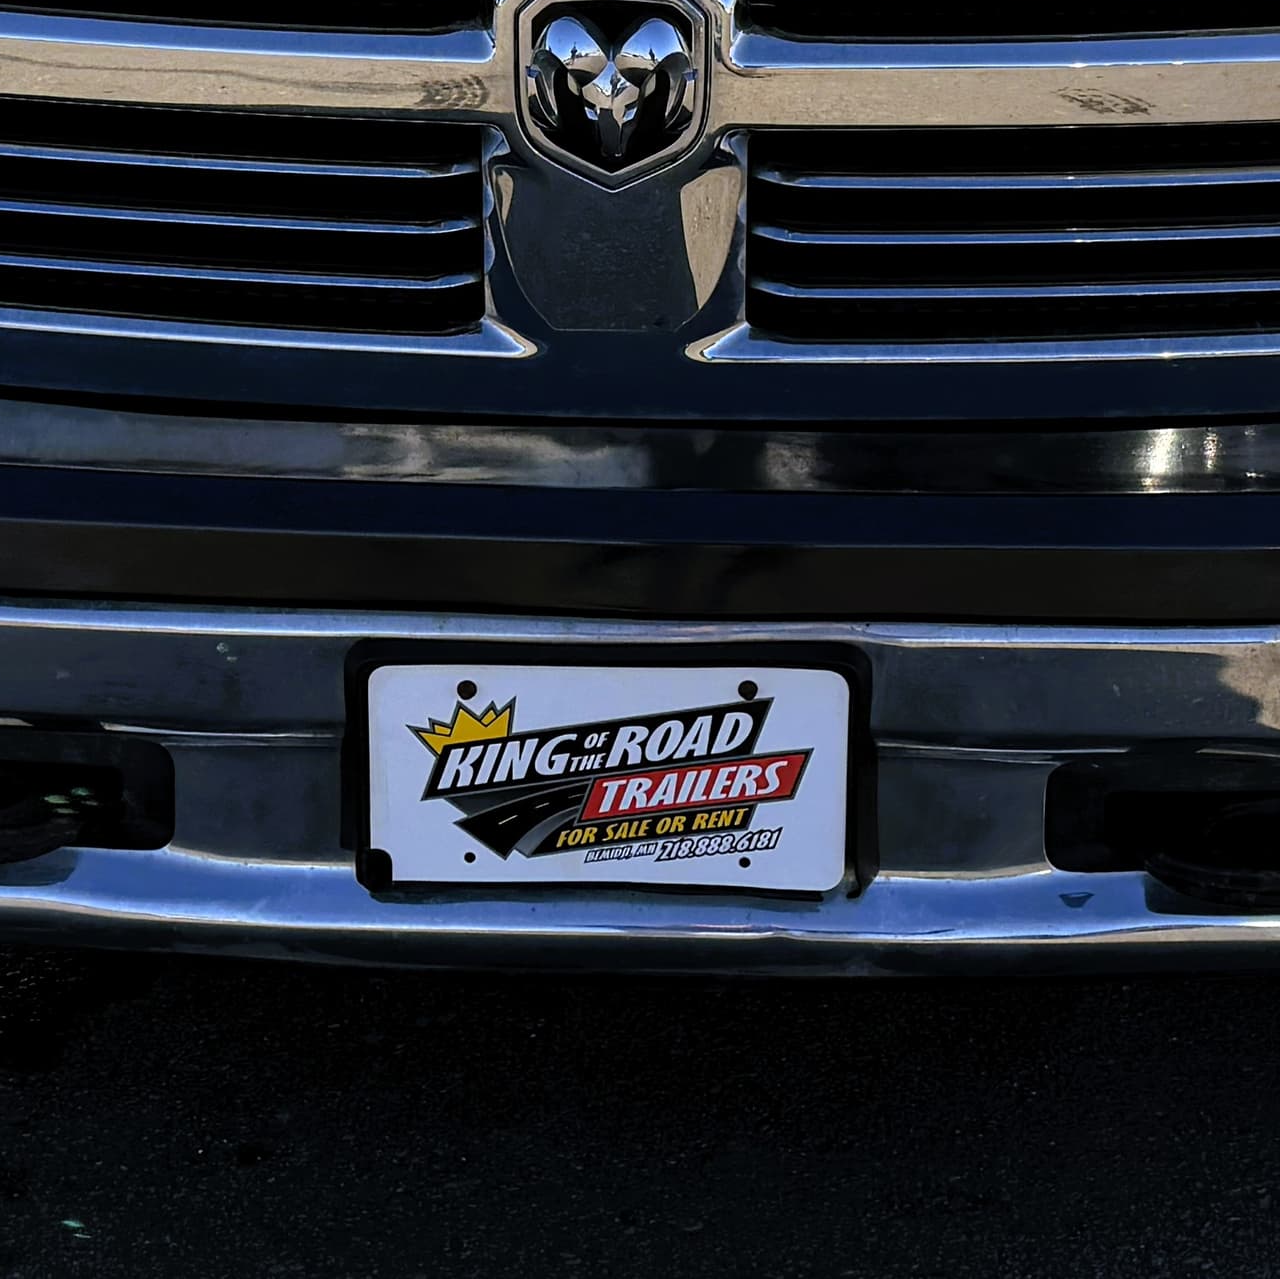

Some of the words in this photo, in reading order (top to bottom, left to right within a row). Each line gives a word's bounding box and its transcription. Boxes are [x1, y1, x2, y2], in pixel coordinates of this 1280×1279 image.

[584, 731, 610, 749] OF
[606, 711, 754, 768] ROAD
[436, 733, 577, 790] KING
[569, 754, 607, 772] THE
[598, 760, 789, 813] TRAILERS
[556, 827, 598, 848] FOR
[602, 819, 653, 842] SALE
[656, 815, 686, 834] OR
[692, 807, 750, 830] RENT
[659, 829, 781, 860] 218.888.6181
